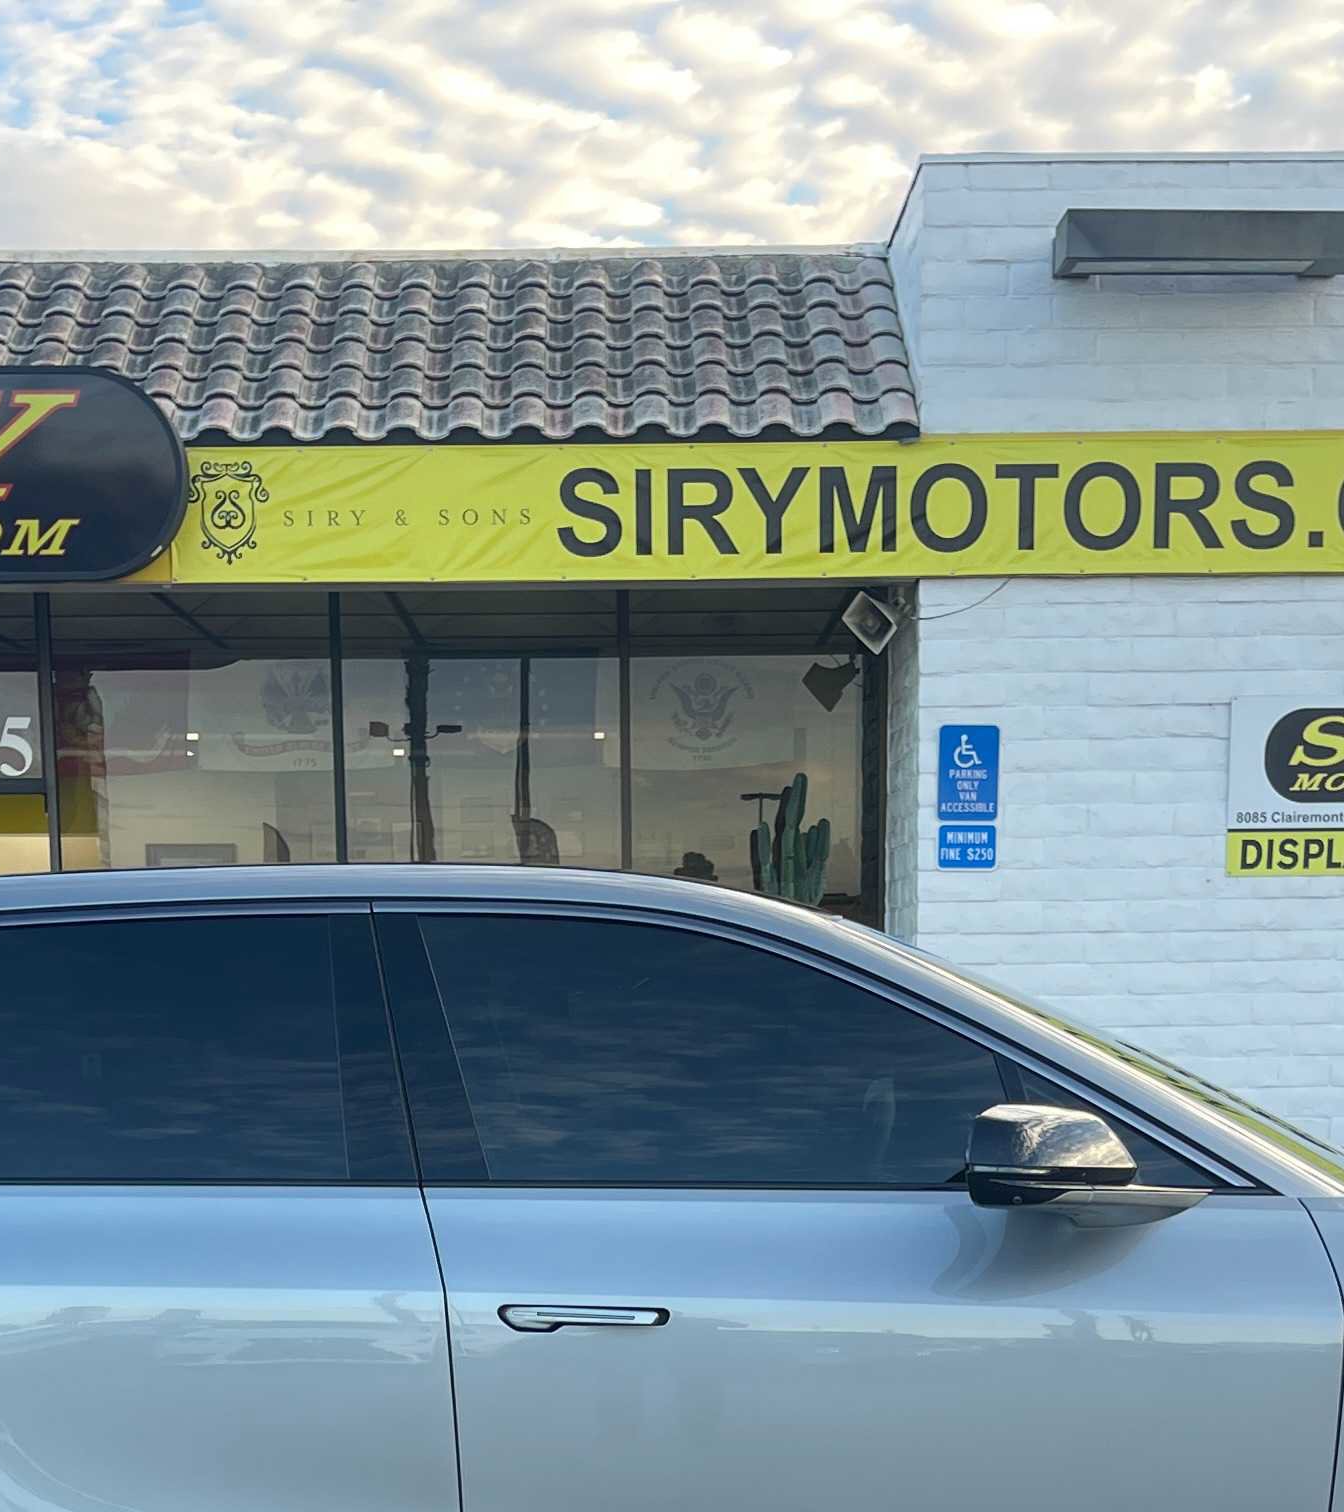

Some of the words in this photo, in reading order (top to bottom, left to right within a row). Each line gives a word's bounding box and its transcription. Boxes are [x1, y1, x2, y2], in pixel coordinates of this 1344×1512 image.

[282, 509, 366, 528] SIRY
[394, 509, 409, 527] &
[438, 508, 531, 527] SONS
[948, 769, 988, 780] PARKING
[956, 780, 980, 791] ONLY
[959, 791, 977, 801] VAN
[940, 802, 995, 813] ACCESSIBLE
[1236, 811, 1267, 824] 8085
[1271, 811, 1344, 824] Clairemont
[946, 832, 989, 845] MINIMUM
[940, 848, 961, 861] FINE
[967, 848, 994, 862] $250
